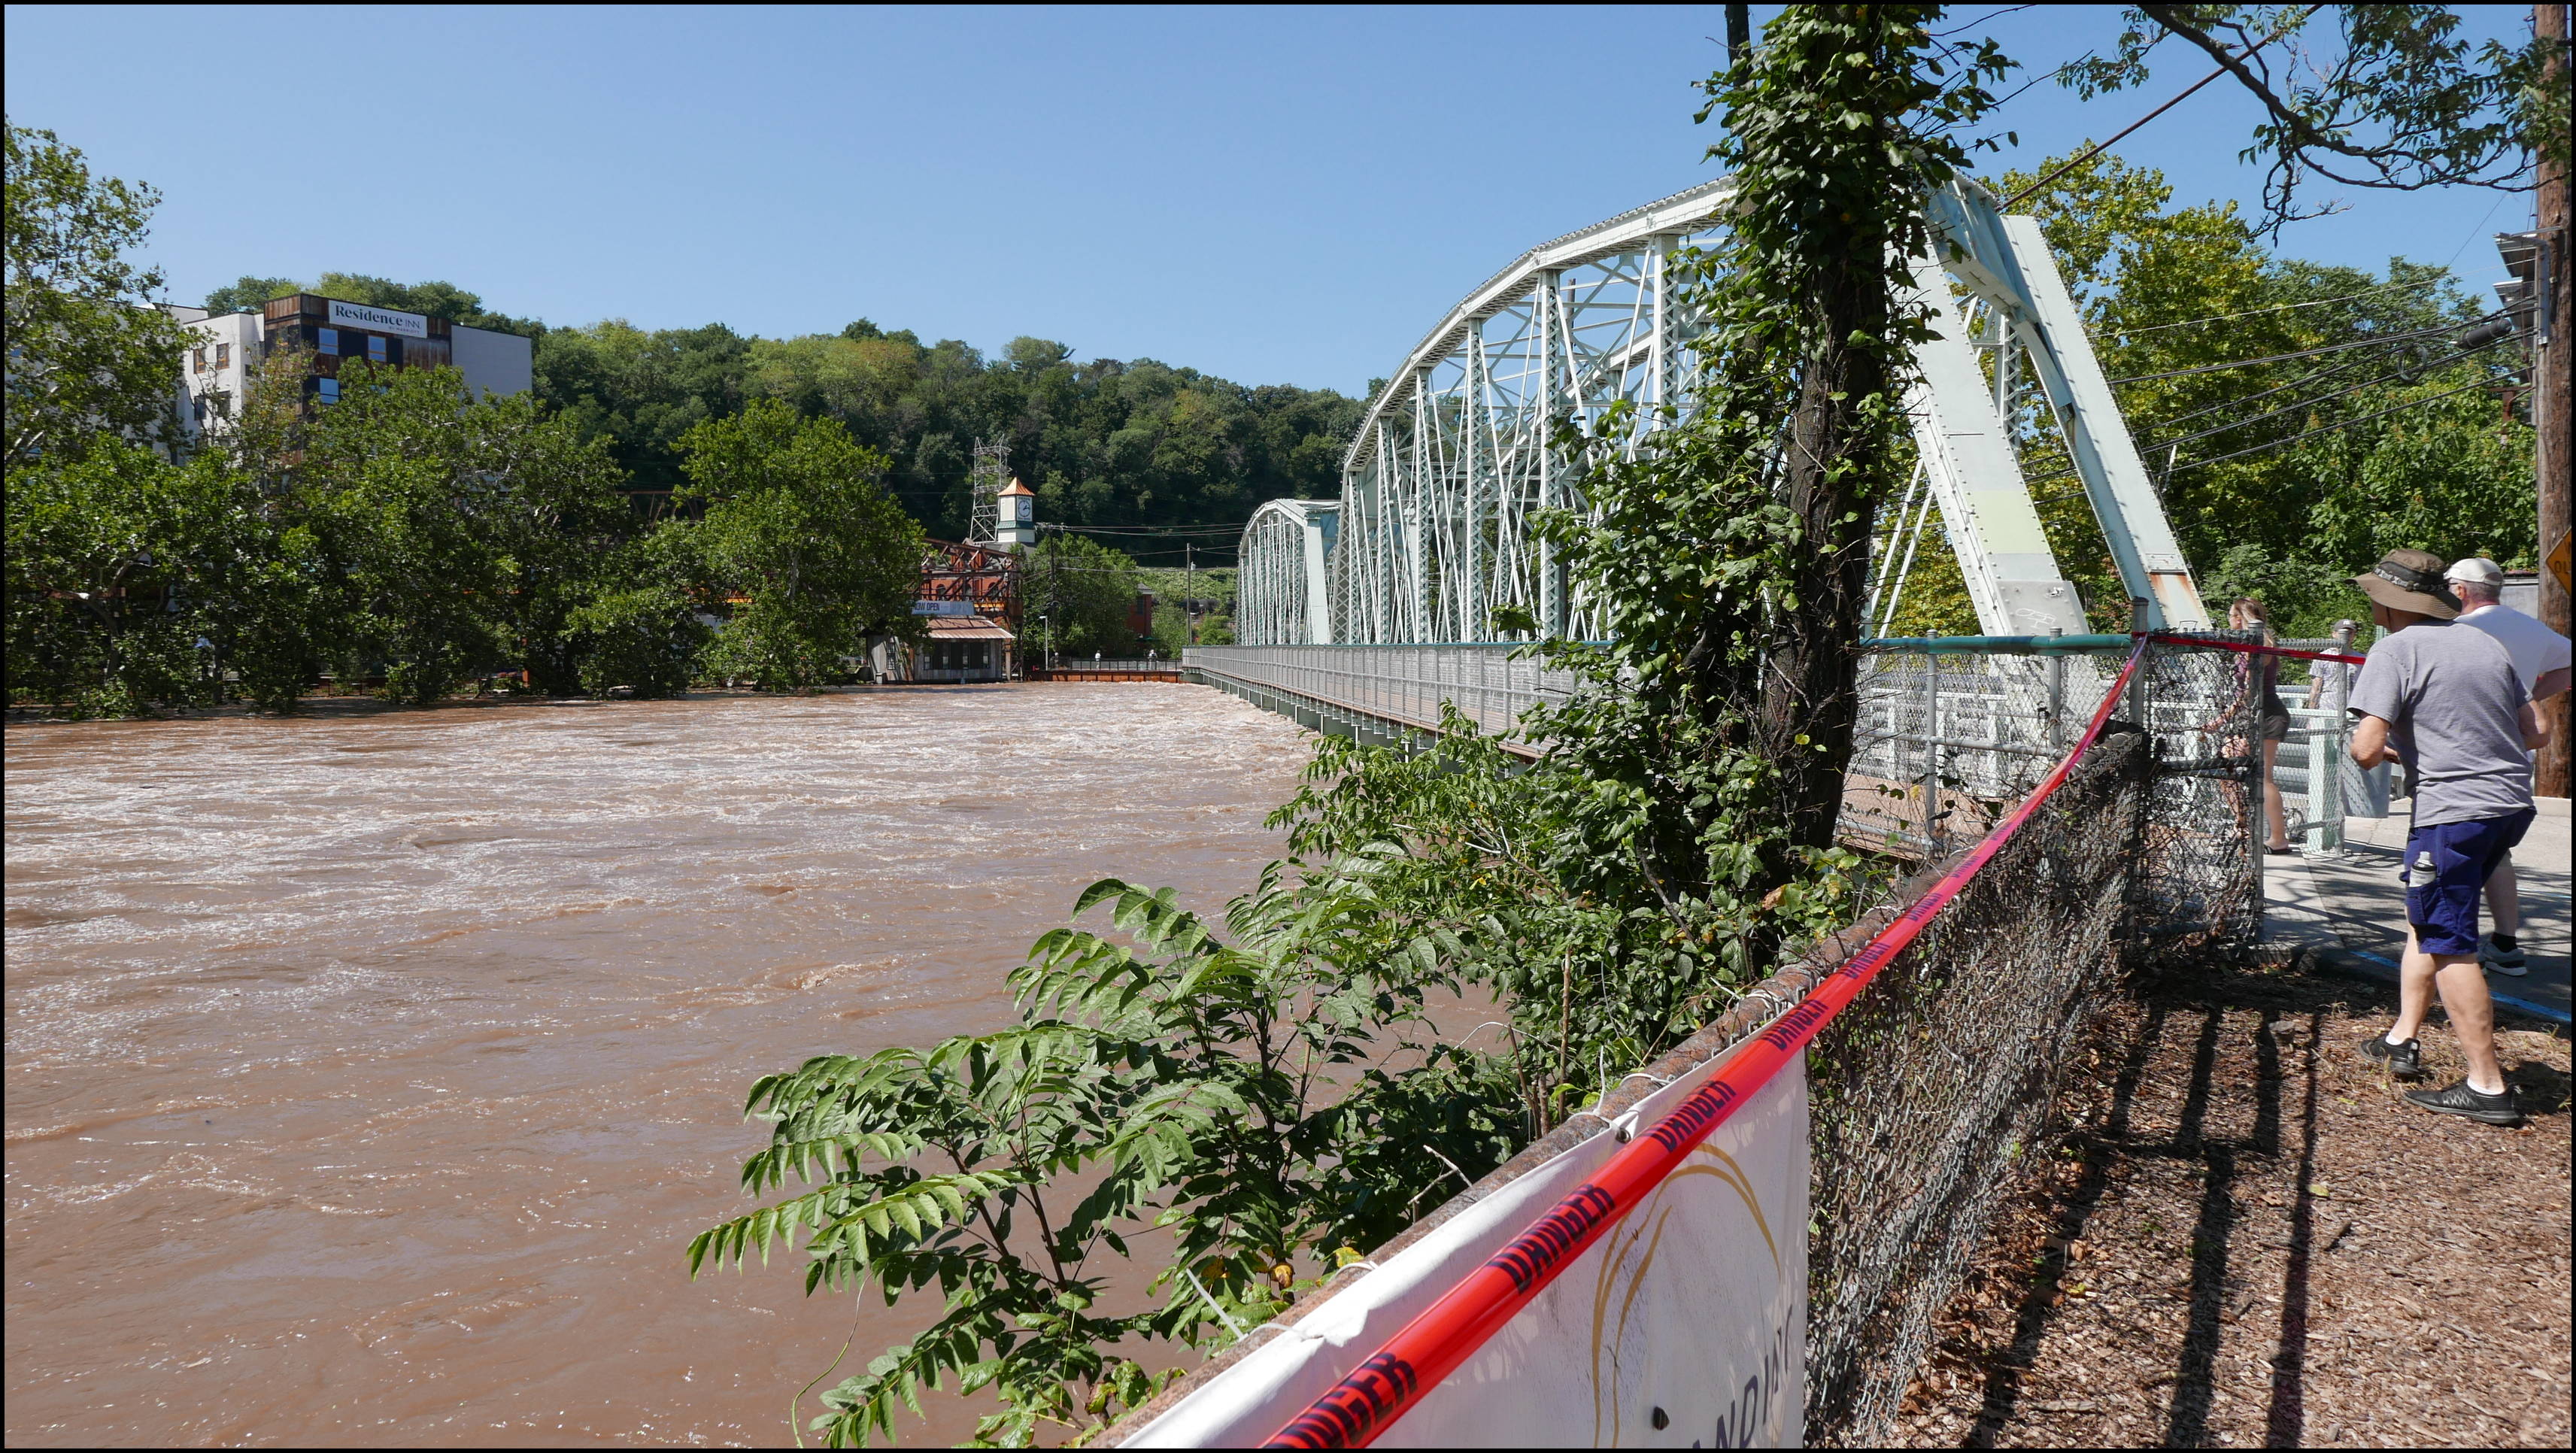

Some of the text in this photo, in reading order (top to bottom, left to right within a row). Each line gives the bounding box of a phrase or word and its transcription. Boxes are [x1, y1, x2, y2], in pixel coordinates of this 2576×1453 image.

[335, 305, 420, 329] Residence INN
[1758, 999, 1829, 1051] DANGER
[1640, 1080, 1737, 1152] DANGER
[1485, 1184, 1616, 1296] DANGER
